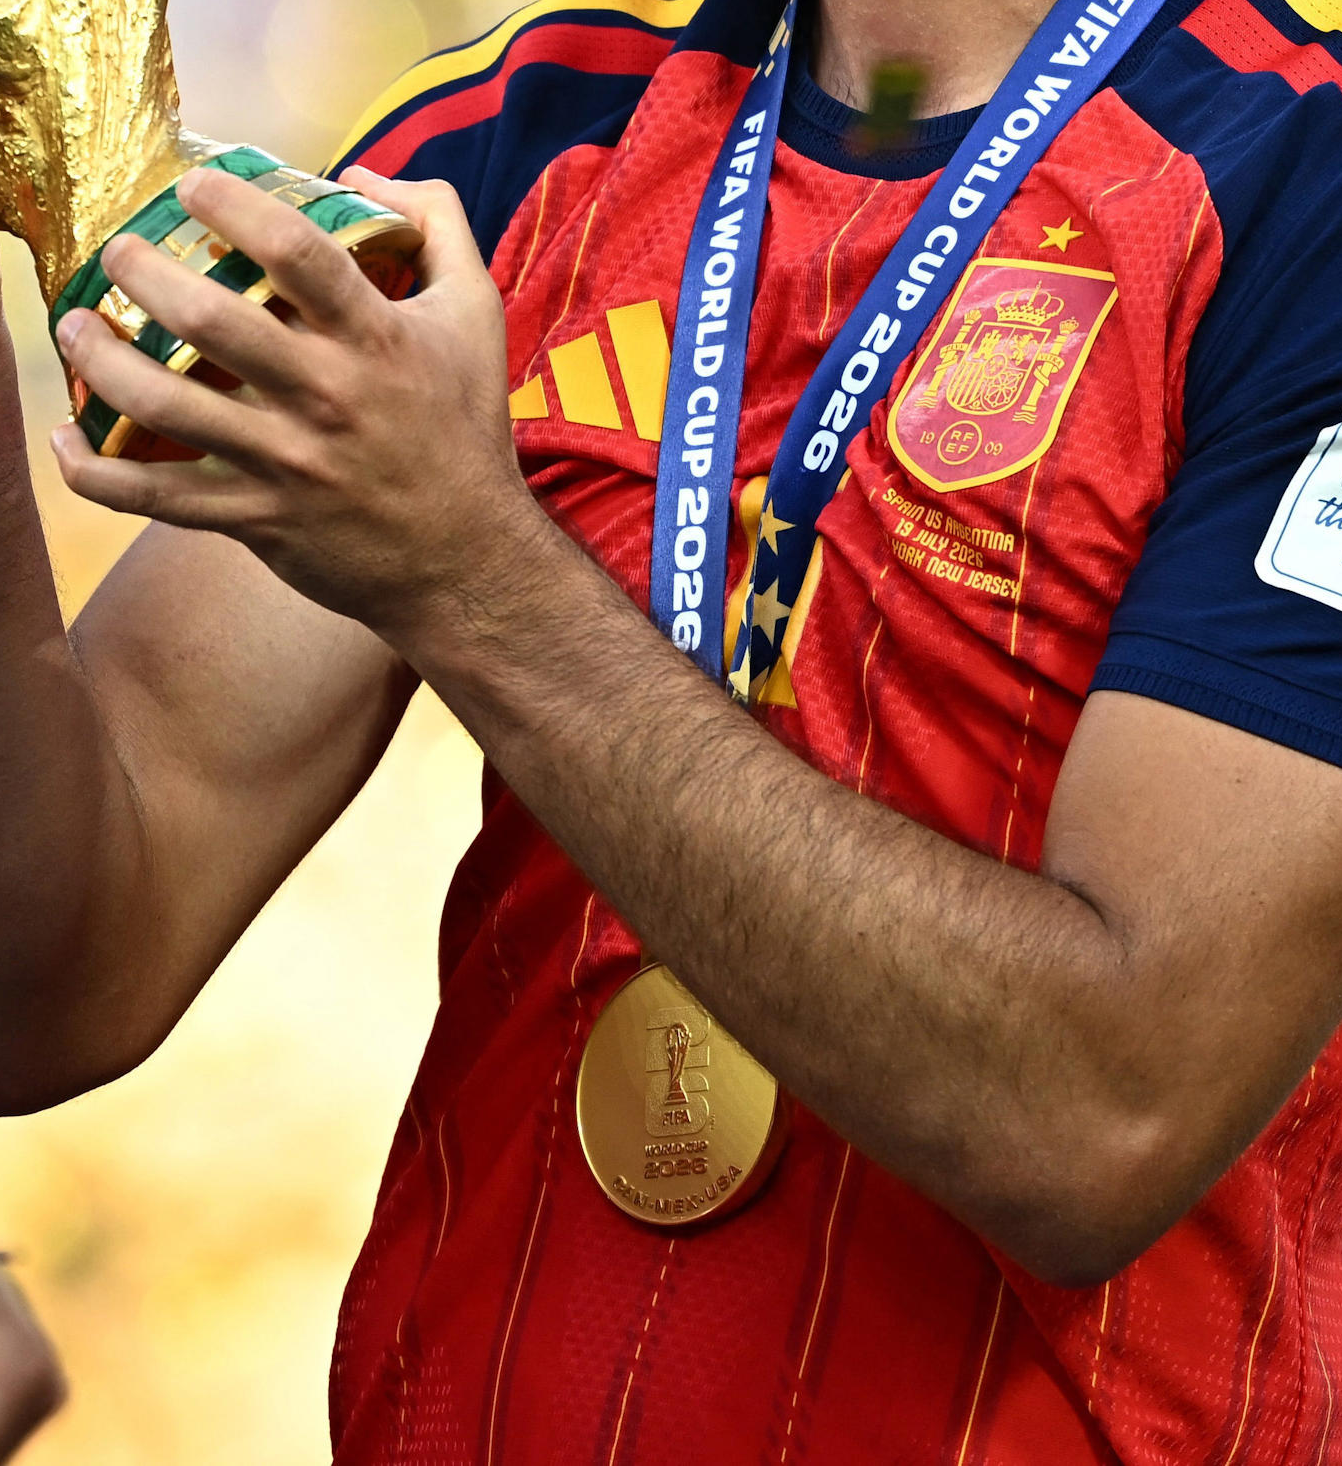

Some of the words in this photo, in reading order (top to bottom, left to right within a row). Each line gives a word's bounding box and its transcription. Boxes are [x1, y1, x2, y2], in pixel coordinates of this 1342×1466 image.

[718, 109, 767, 208] FIFA
[948, 74, 1072, 219] WORLD
[692, 208, 745, 378] WORLD
[895, 224, 959, 311] CUP
[802, 312, 902, 473] 2026
[681, 385, 719, 478] CUP
[919, 430, 935, 444] 19
[944, 443, 970, 454] EF
[950, 430, 975, 442] RF
[984, 441, 1003, 456] 09
[881, 487, 925, 521] SPAIN
[944, 516, 1015, 553] ARGENTINA
[894, 517, 915, 537] 19
[912, 528, 950, 554] JULY
[948, 541, 984, 568] 2026
[671, 486, 710, 654] 2026
[891, 538, 926, 569] YORK
[925, 556, 965, 583] NEW
[964, 569, 1021, 599] JERSEY
[662, 1109, 692, 1126] FIFA
[644, 1141, 685, 1158] WORLD
[685, 1139, 709, 1154] CUP
[644, 1157, 708, 1180] 2026
